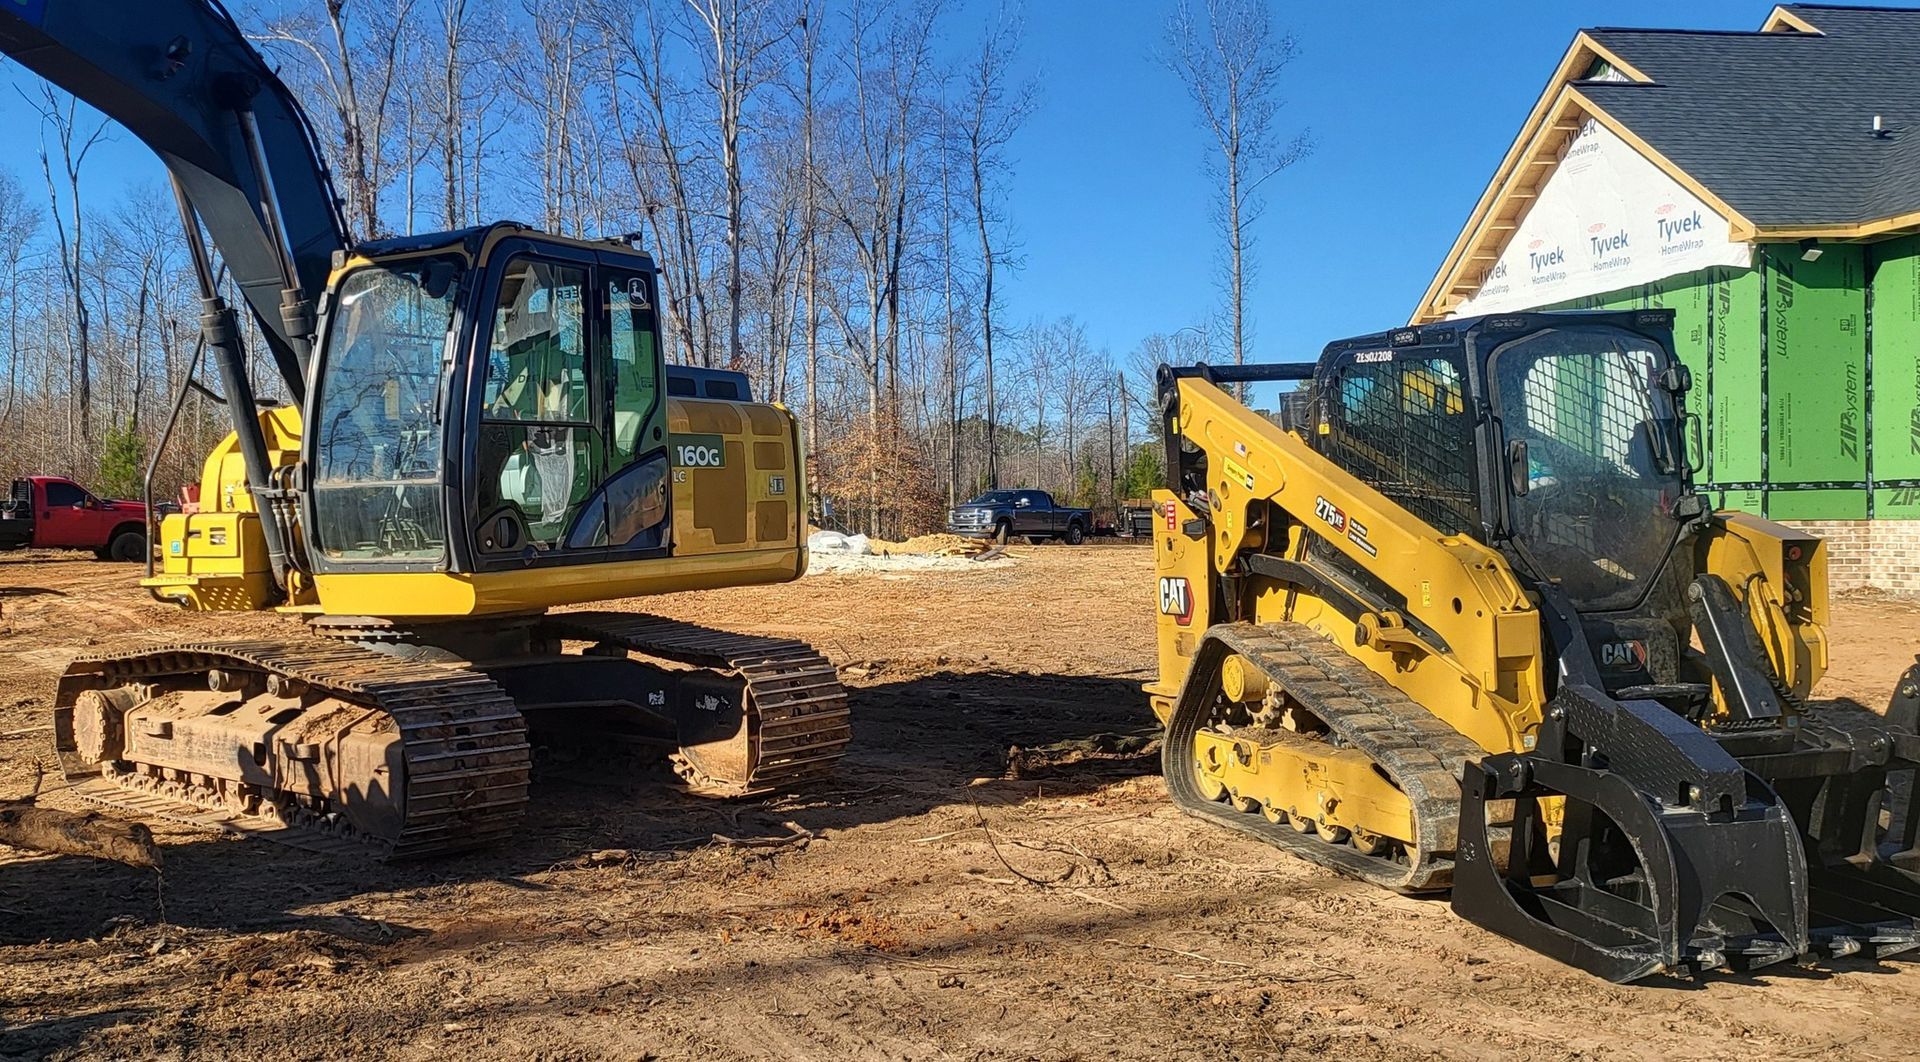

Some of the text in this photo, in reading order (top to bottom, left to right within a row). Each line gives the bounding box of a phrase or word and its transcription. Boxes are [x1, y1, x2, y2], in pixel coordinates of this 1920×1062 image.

[1657, 210, 1702, 242] Tyvek
[1590, 228, 1629, 259] Tyvek
[1661, 239, 1704, 256] HomeWrap
[1529, 245, 1565, 273] Tyvek
[1593, 255, 1631, 272] HomeWrap
[1531, 271, 1567, 285] HomeWrap
[677, 445, 720, 466] 160G
[673, 470, 687, 482] LC
[1160, 577, 1186, 615] CAT
[1601, 643, 1634, 665] CAT
